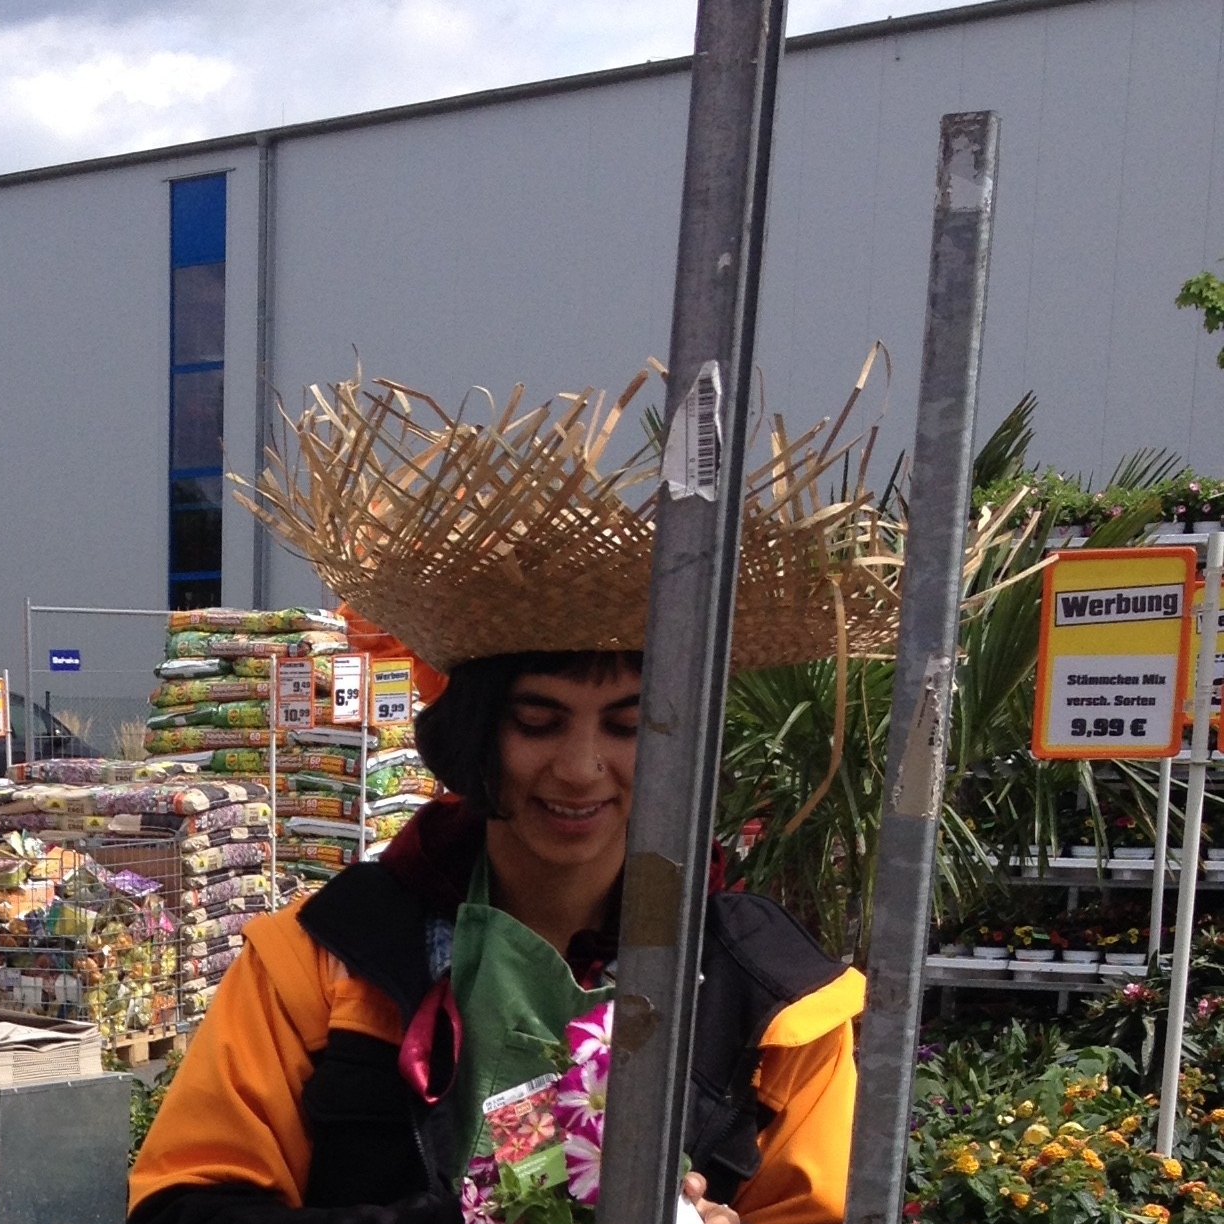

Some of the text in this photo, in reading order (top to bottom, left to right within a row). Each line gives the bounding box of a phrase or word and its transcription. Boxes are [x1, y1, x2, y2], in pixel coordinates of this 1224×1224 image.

[1060, 593, 1178, 618] Werbung
[1067, 674, 1166, 686] Stämmchen Mix
[1066, 695, 1156, 706] versch. Sorten
[1070, 718, 1147, 738] 9,99 €
